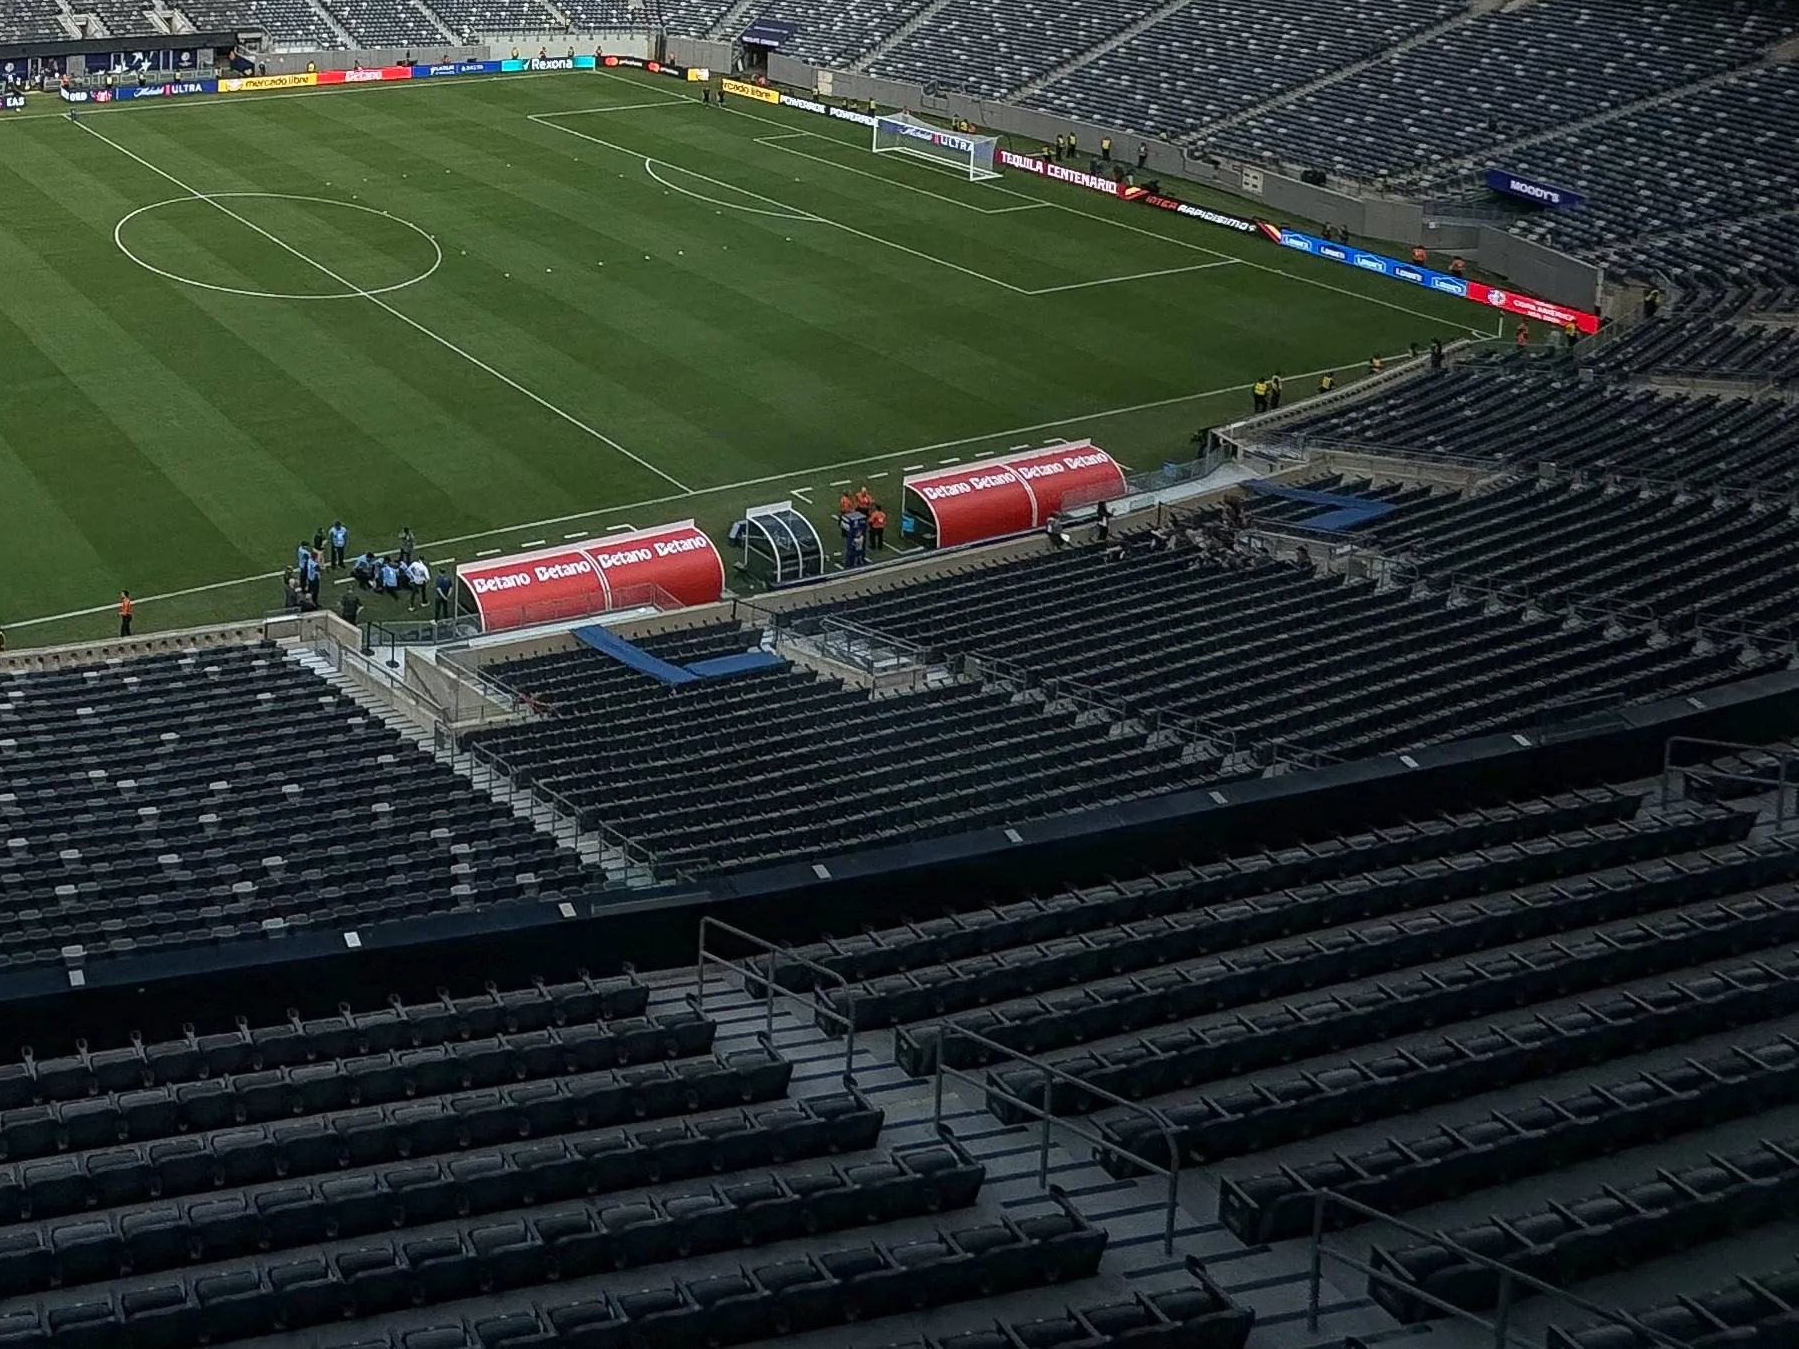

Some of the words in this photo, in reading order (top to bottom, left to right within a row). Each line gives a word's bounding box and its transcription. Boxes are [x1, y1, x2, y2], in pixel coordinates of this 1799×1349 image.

[531, 58, 573, 71] Rexona
[171, 83, 202, 93] ULTRA
[245, 78, 287, 89] mercado
[288, 75, 309, 85] libre
[1001, 151, 1044, 174] TEQUILA
[1047, 165, 1118, 195] CENTENARIO
[1510, 179, 1560, 204] MOODY'S
[1145, 195, 1179, 211] INTER
[1063, 453, 1108, 470] Betano
[1020, 463, 1065, 480] Betano
[969, 472, 1016, 490] Betano
[922, 482, 971, 501] Betano
[653, 536, 707, 558] Betano
[597, 548, 653, 570] Betano
[534, 560, 592, 582] Betano
[473, 571, 531, 594] Betano
